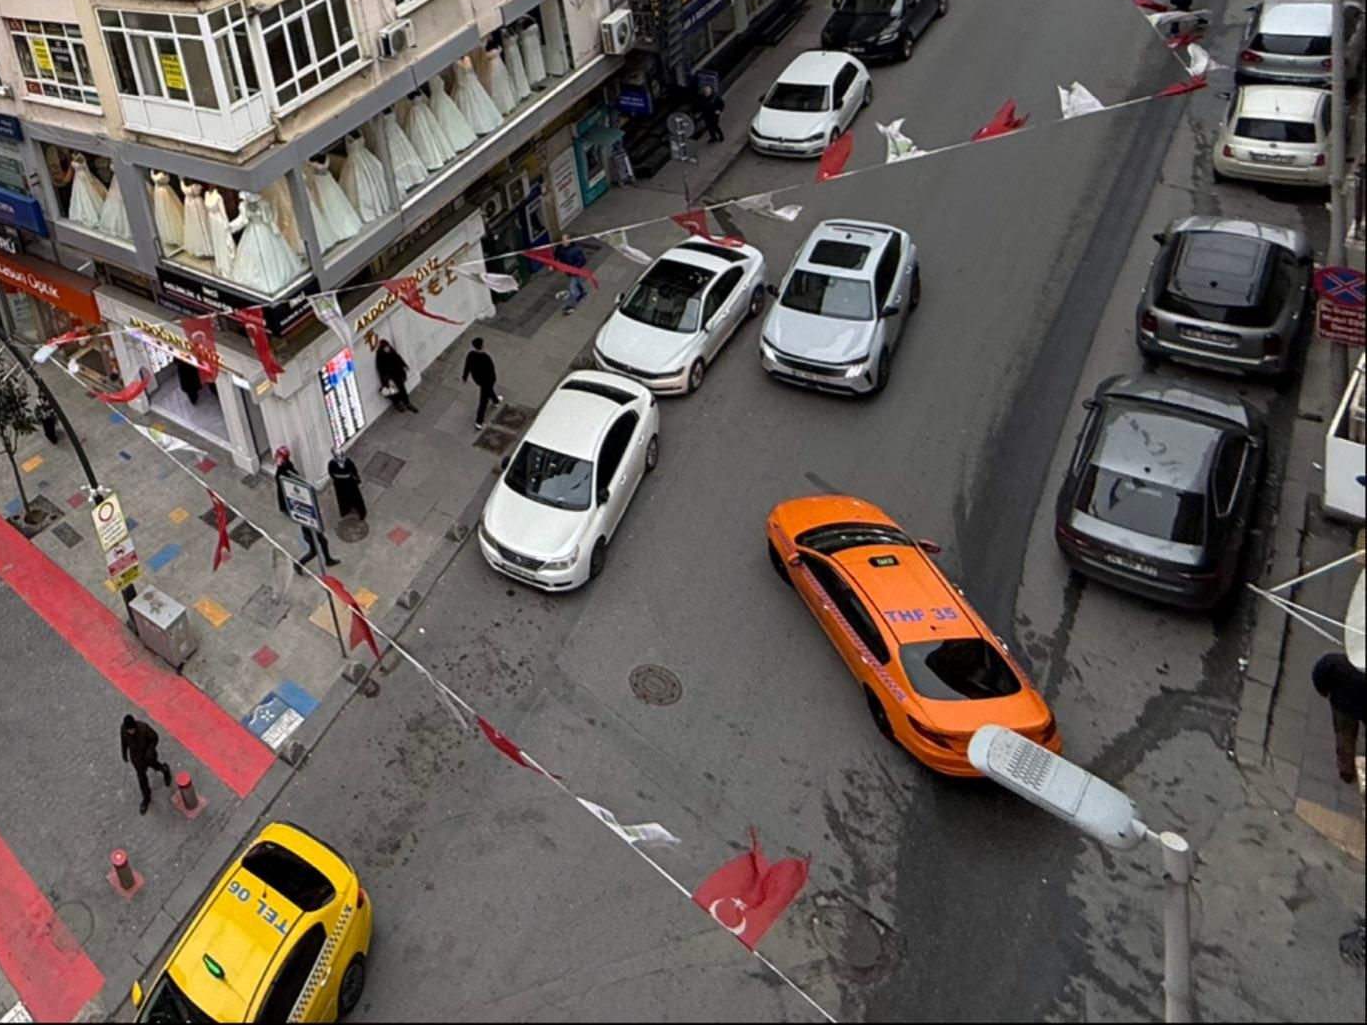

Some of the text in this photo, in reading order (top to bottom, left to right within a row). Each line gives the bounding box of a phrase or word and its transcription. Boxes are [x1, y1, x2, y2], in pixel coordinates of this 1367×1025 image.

[929, 606, 959, 622] 35
[227, 879, 289, 936] TEL 06
